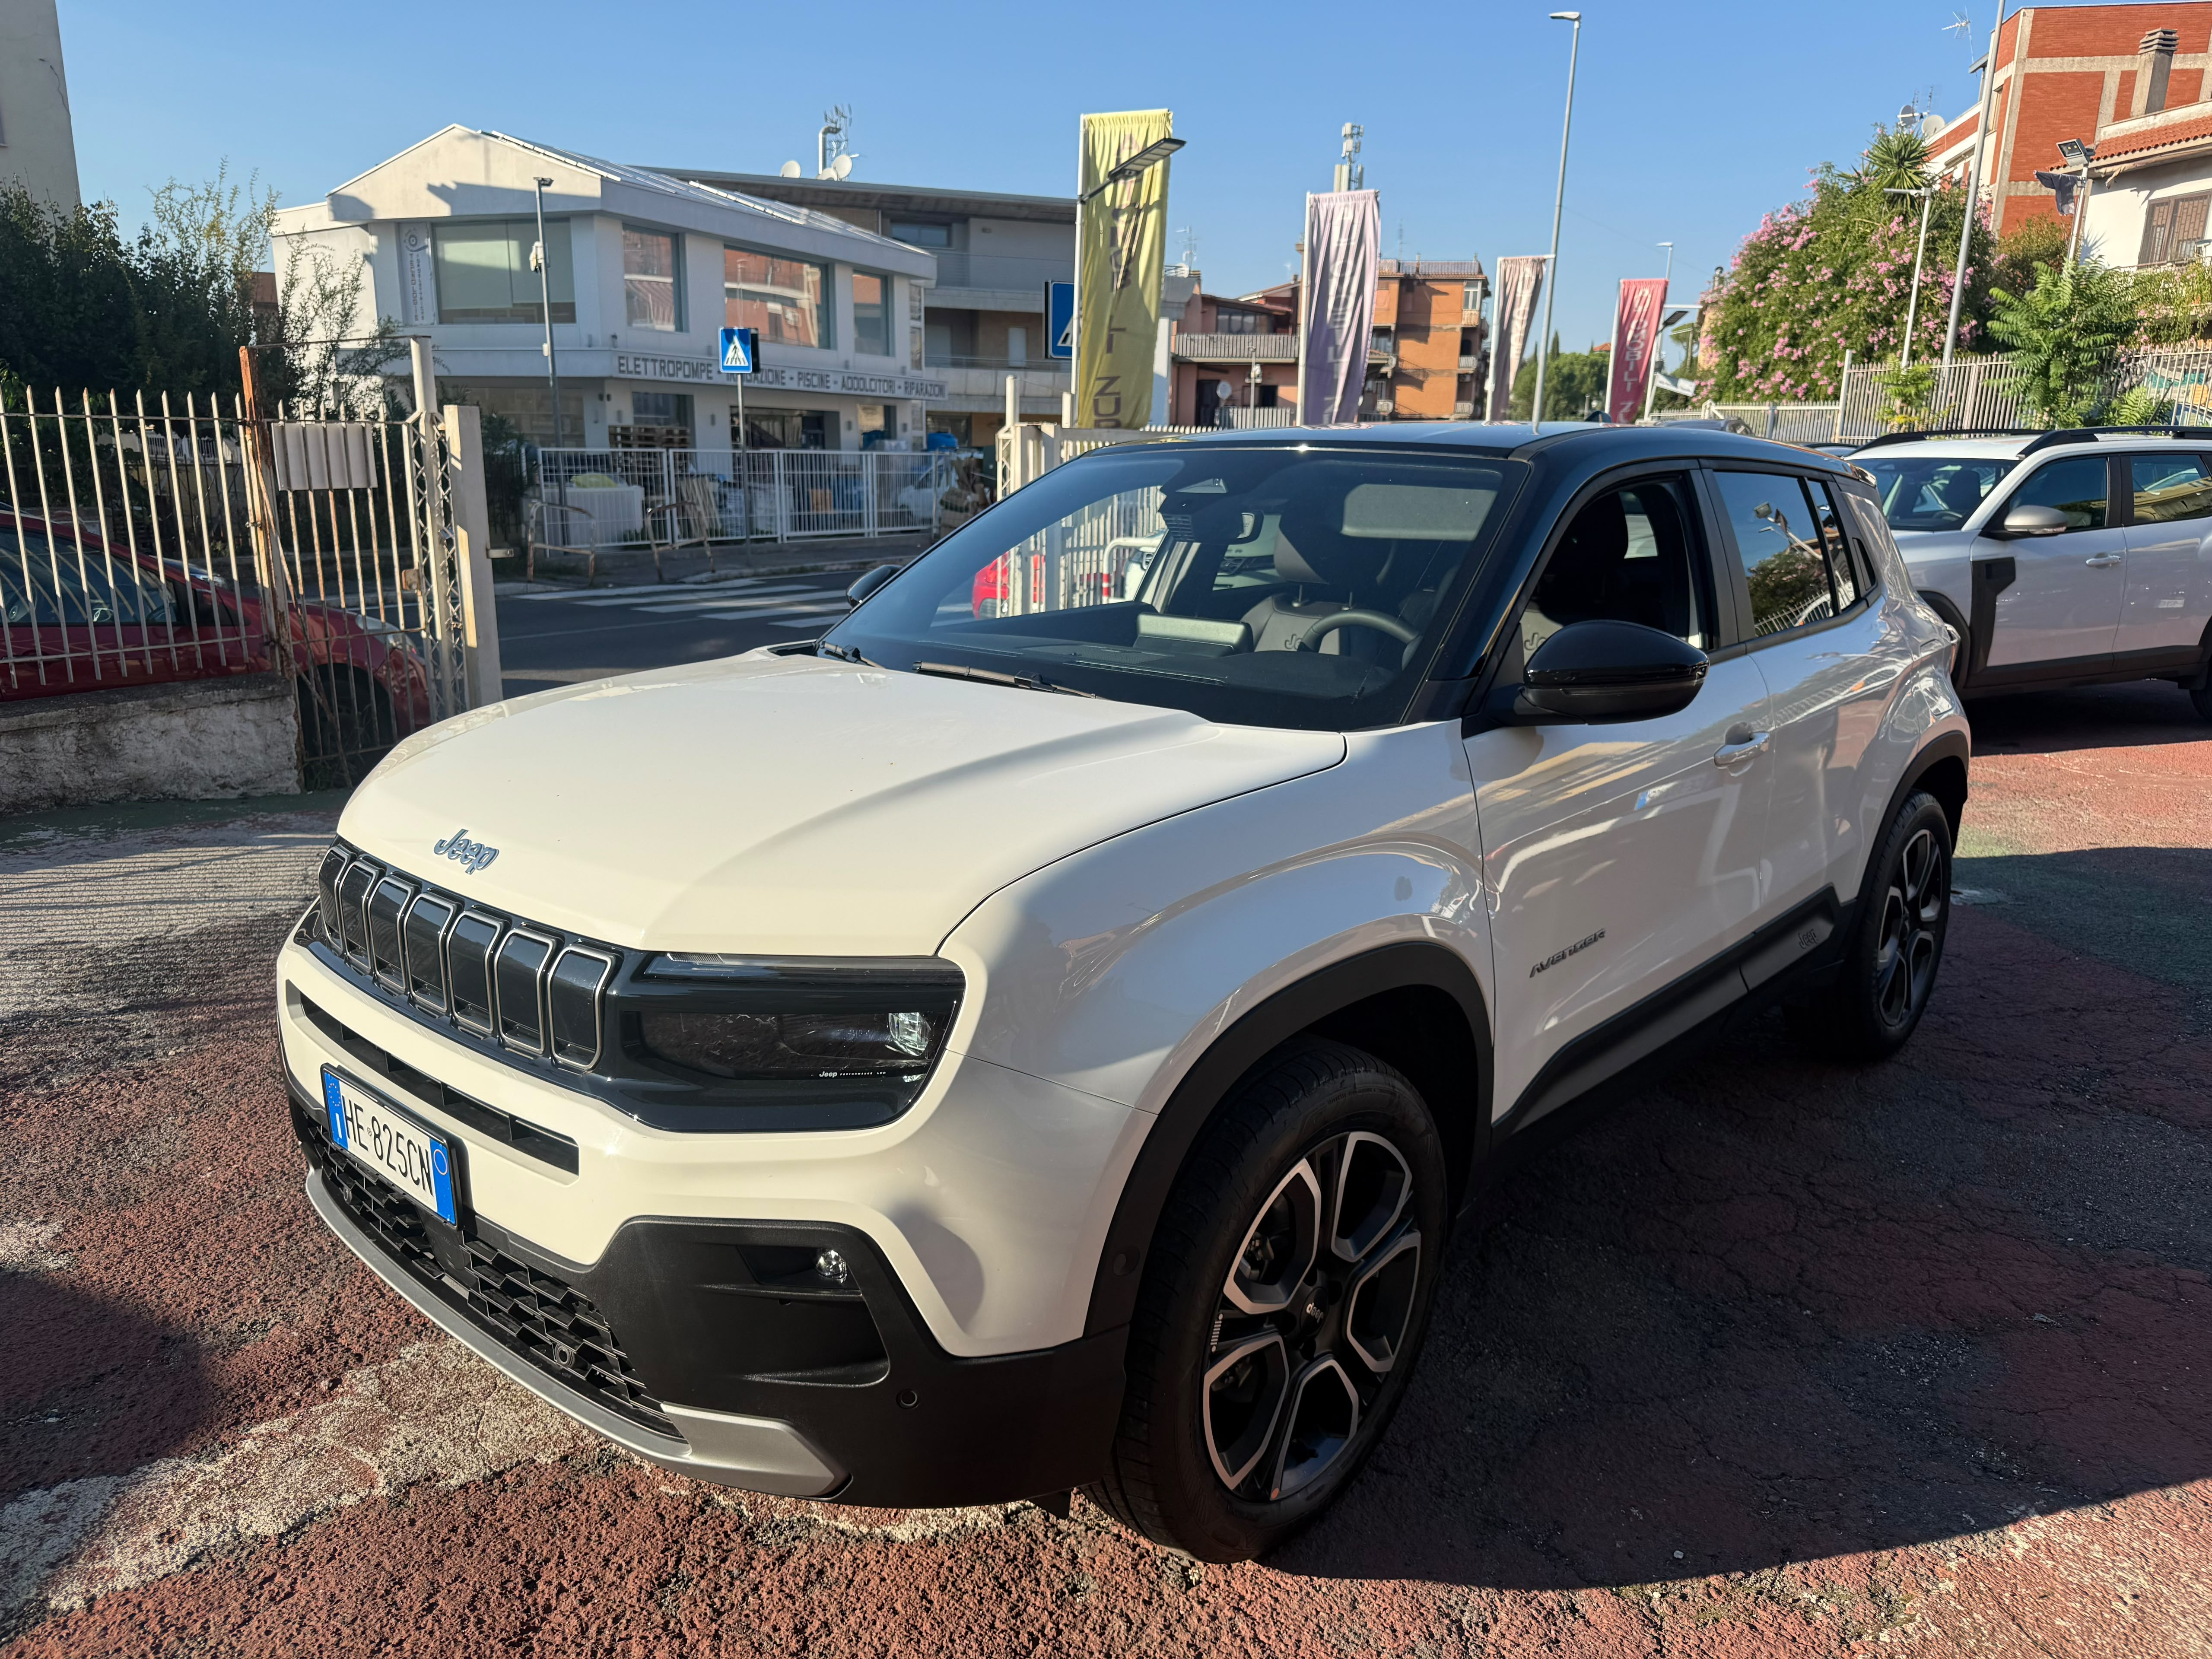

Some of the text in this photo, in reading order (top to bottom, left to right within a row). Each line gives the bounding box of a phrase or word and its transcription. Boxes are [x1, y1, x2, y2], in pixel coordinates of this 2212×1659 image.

[618, 356, 713, 380] ELETTROPOMPE
[726, 368, 786, 386] IRIGAZIONE
[797, 371, 830, 389] PISCINE
[433, 828, 499, 875] Jeep
[1529, 928, 1605, 978] AVENGER
[1799, 928, 1818, 950] Jeep
[342, 1095, 434, 1196] HE 825CN
[1306, 1302, 1324, 1323] Jeep
